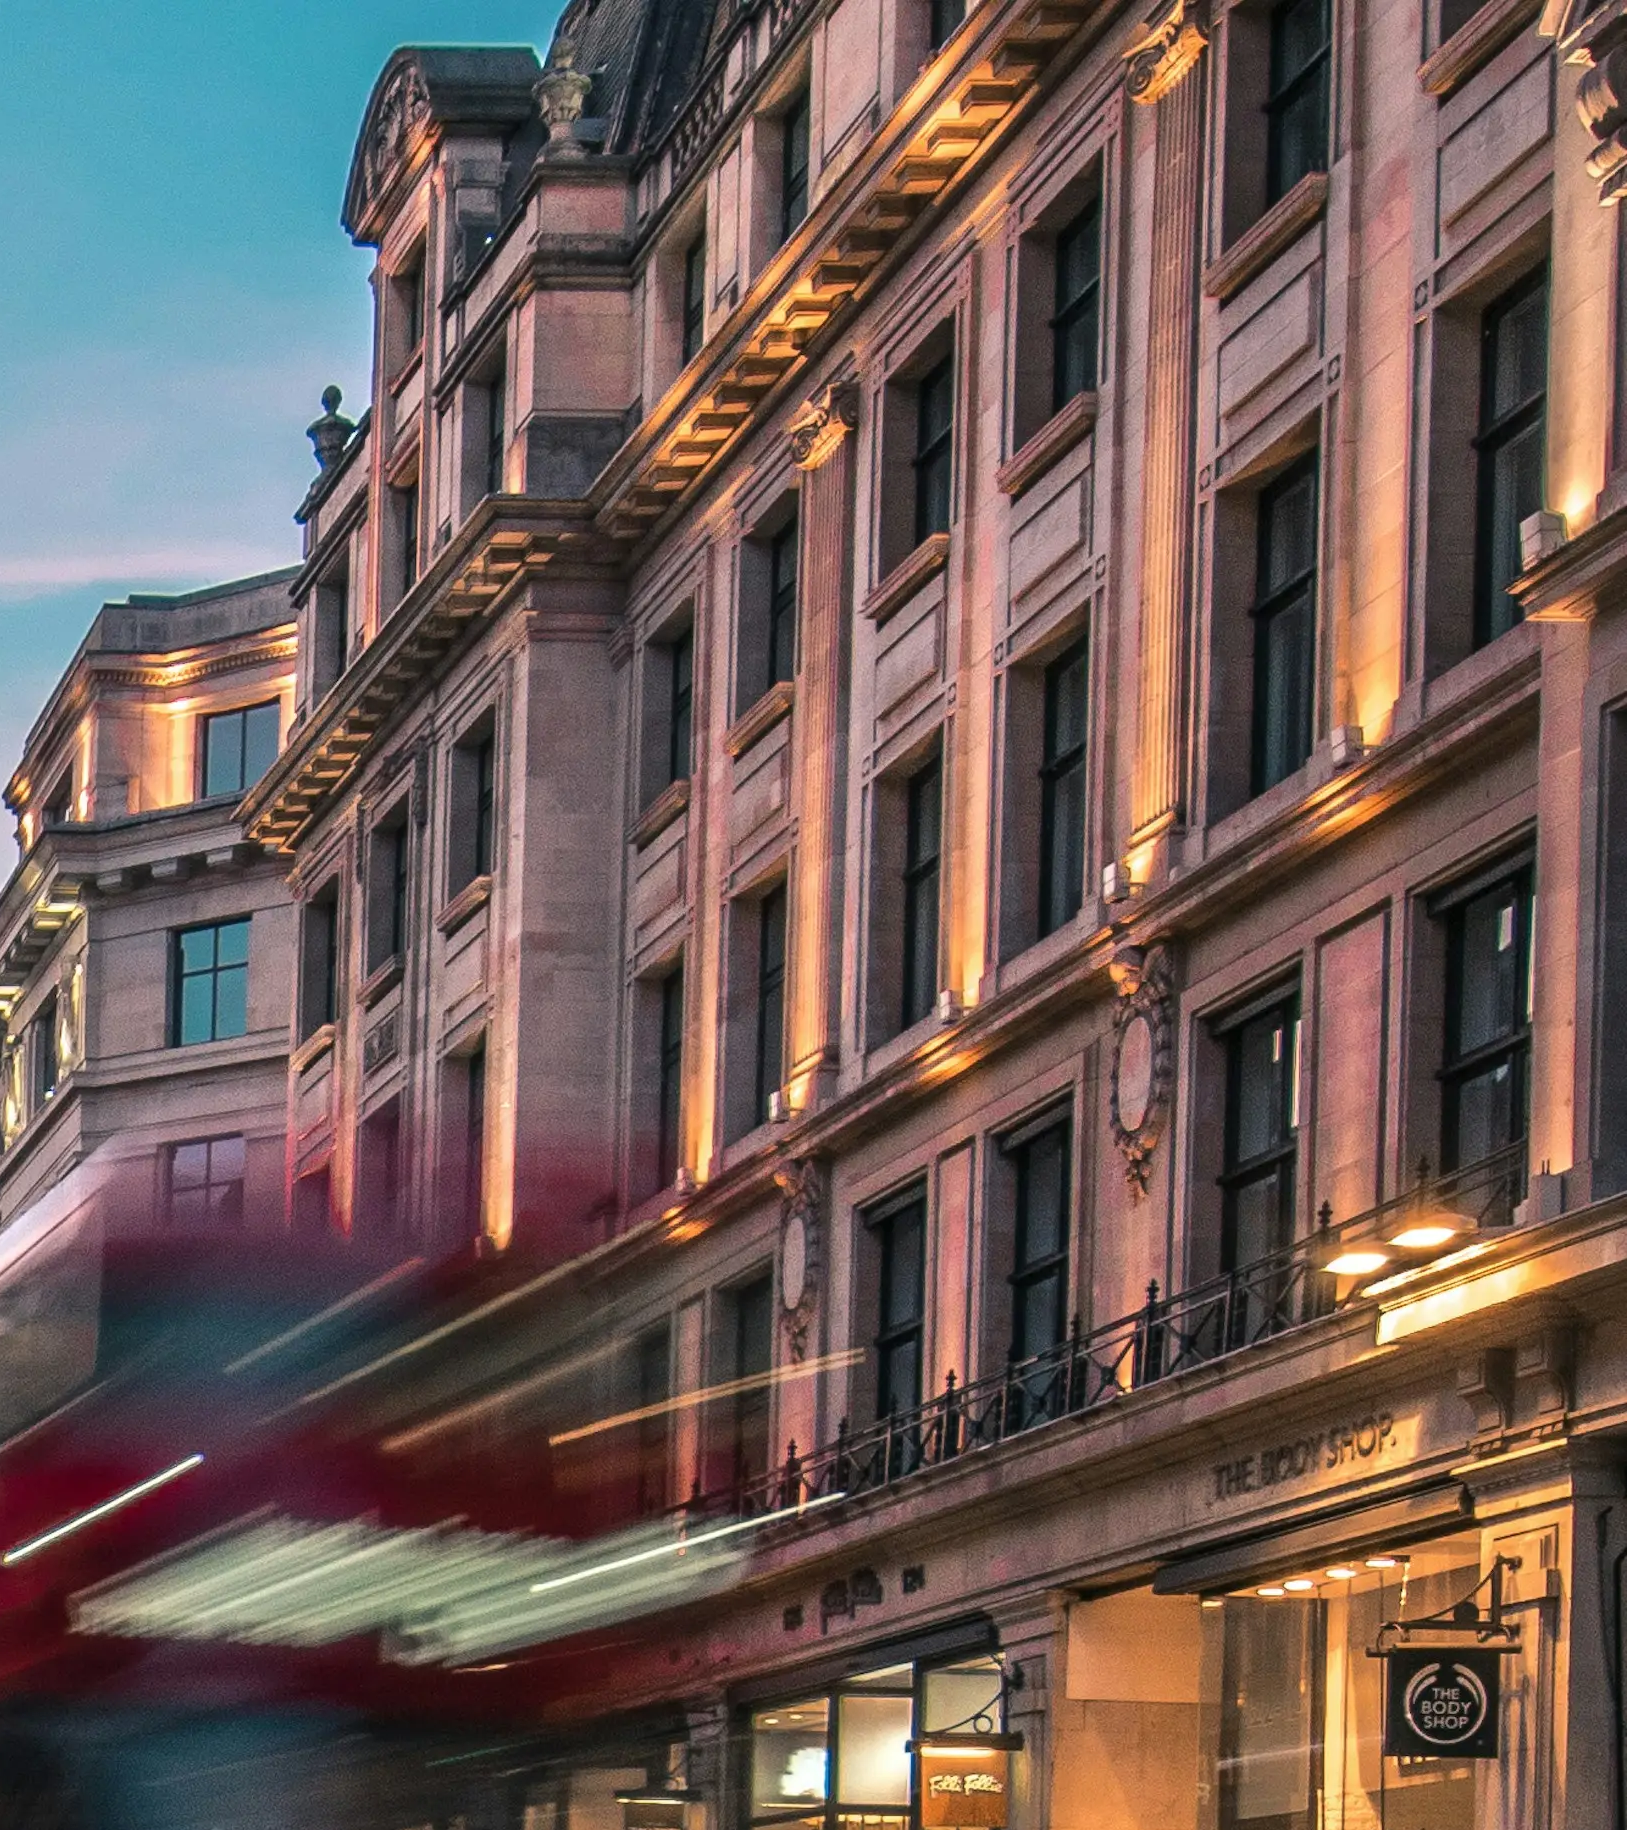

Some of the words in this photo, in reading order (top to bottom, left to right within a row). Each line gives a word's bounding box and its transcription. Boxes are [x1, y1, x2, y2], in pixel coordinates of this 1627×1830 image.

[1214, 1456, 1262, 1499] THE
[1432, 1687, 1460, 1700] THE
[1421, 1701, 1472, 1715] BODY
[1423, 1716, 1469, 1729] SHOP
